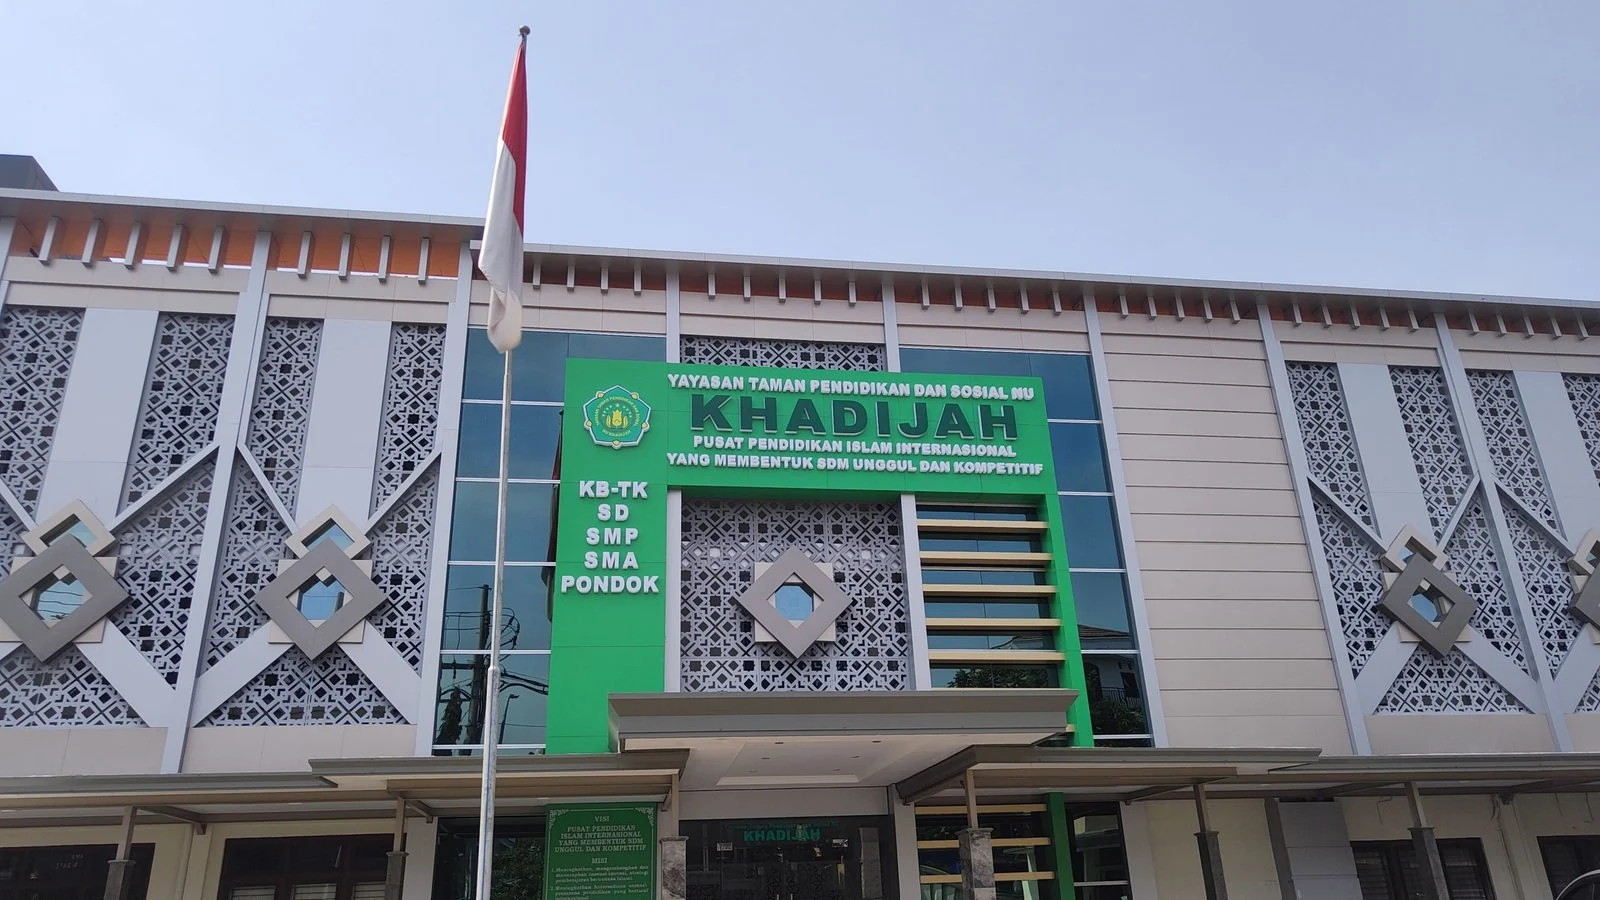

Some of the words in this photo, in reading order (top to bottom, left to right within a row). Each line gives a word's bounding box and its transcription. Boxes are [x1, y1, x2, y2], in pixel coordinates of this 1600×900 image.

[667, 374, 744, 390] YAYASAN
[749, 377, 805, 393] TAMAN
[810, 380, 911, 397] PENDIDIKAN
[914, 384, 947, 398] DAN
[951, 385, 1008, 400] SOSIAL
[1011, 387, 1034, 401] NU
[691, 394, 1018, 440] KHADIJAH
[693, 435, 744, 449] PUSAT
[748, 437, 843, 452] PENDIDIKAN
[847, 441, 893, 454] ISLAM
[896, 442, 1017, 457] INTERNASIONAL
[667, 453, 710, 466] YANG
[714, 454, 813, 470] MEMBENTUK
[816, 458, 849, 470] SDM
[853, 459, 917, 472] UNGGUL
[919, 461, 950, 473] DAN
[953, 461, 1044, 475] KOMPETITIF
[579, 480, 648, 498] KB-TK
[597, 503, 629, 521] SD
[586, 527, 638, 545] SMP
[584, 551, 638, 569] SMA
[561, 575, 659, 593] PONDOK
[585, 831, 642, 839] INTERNASIONAL
[743, 829, 821, 841] KHADIJAH
